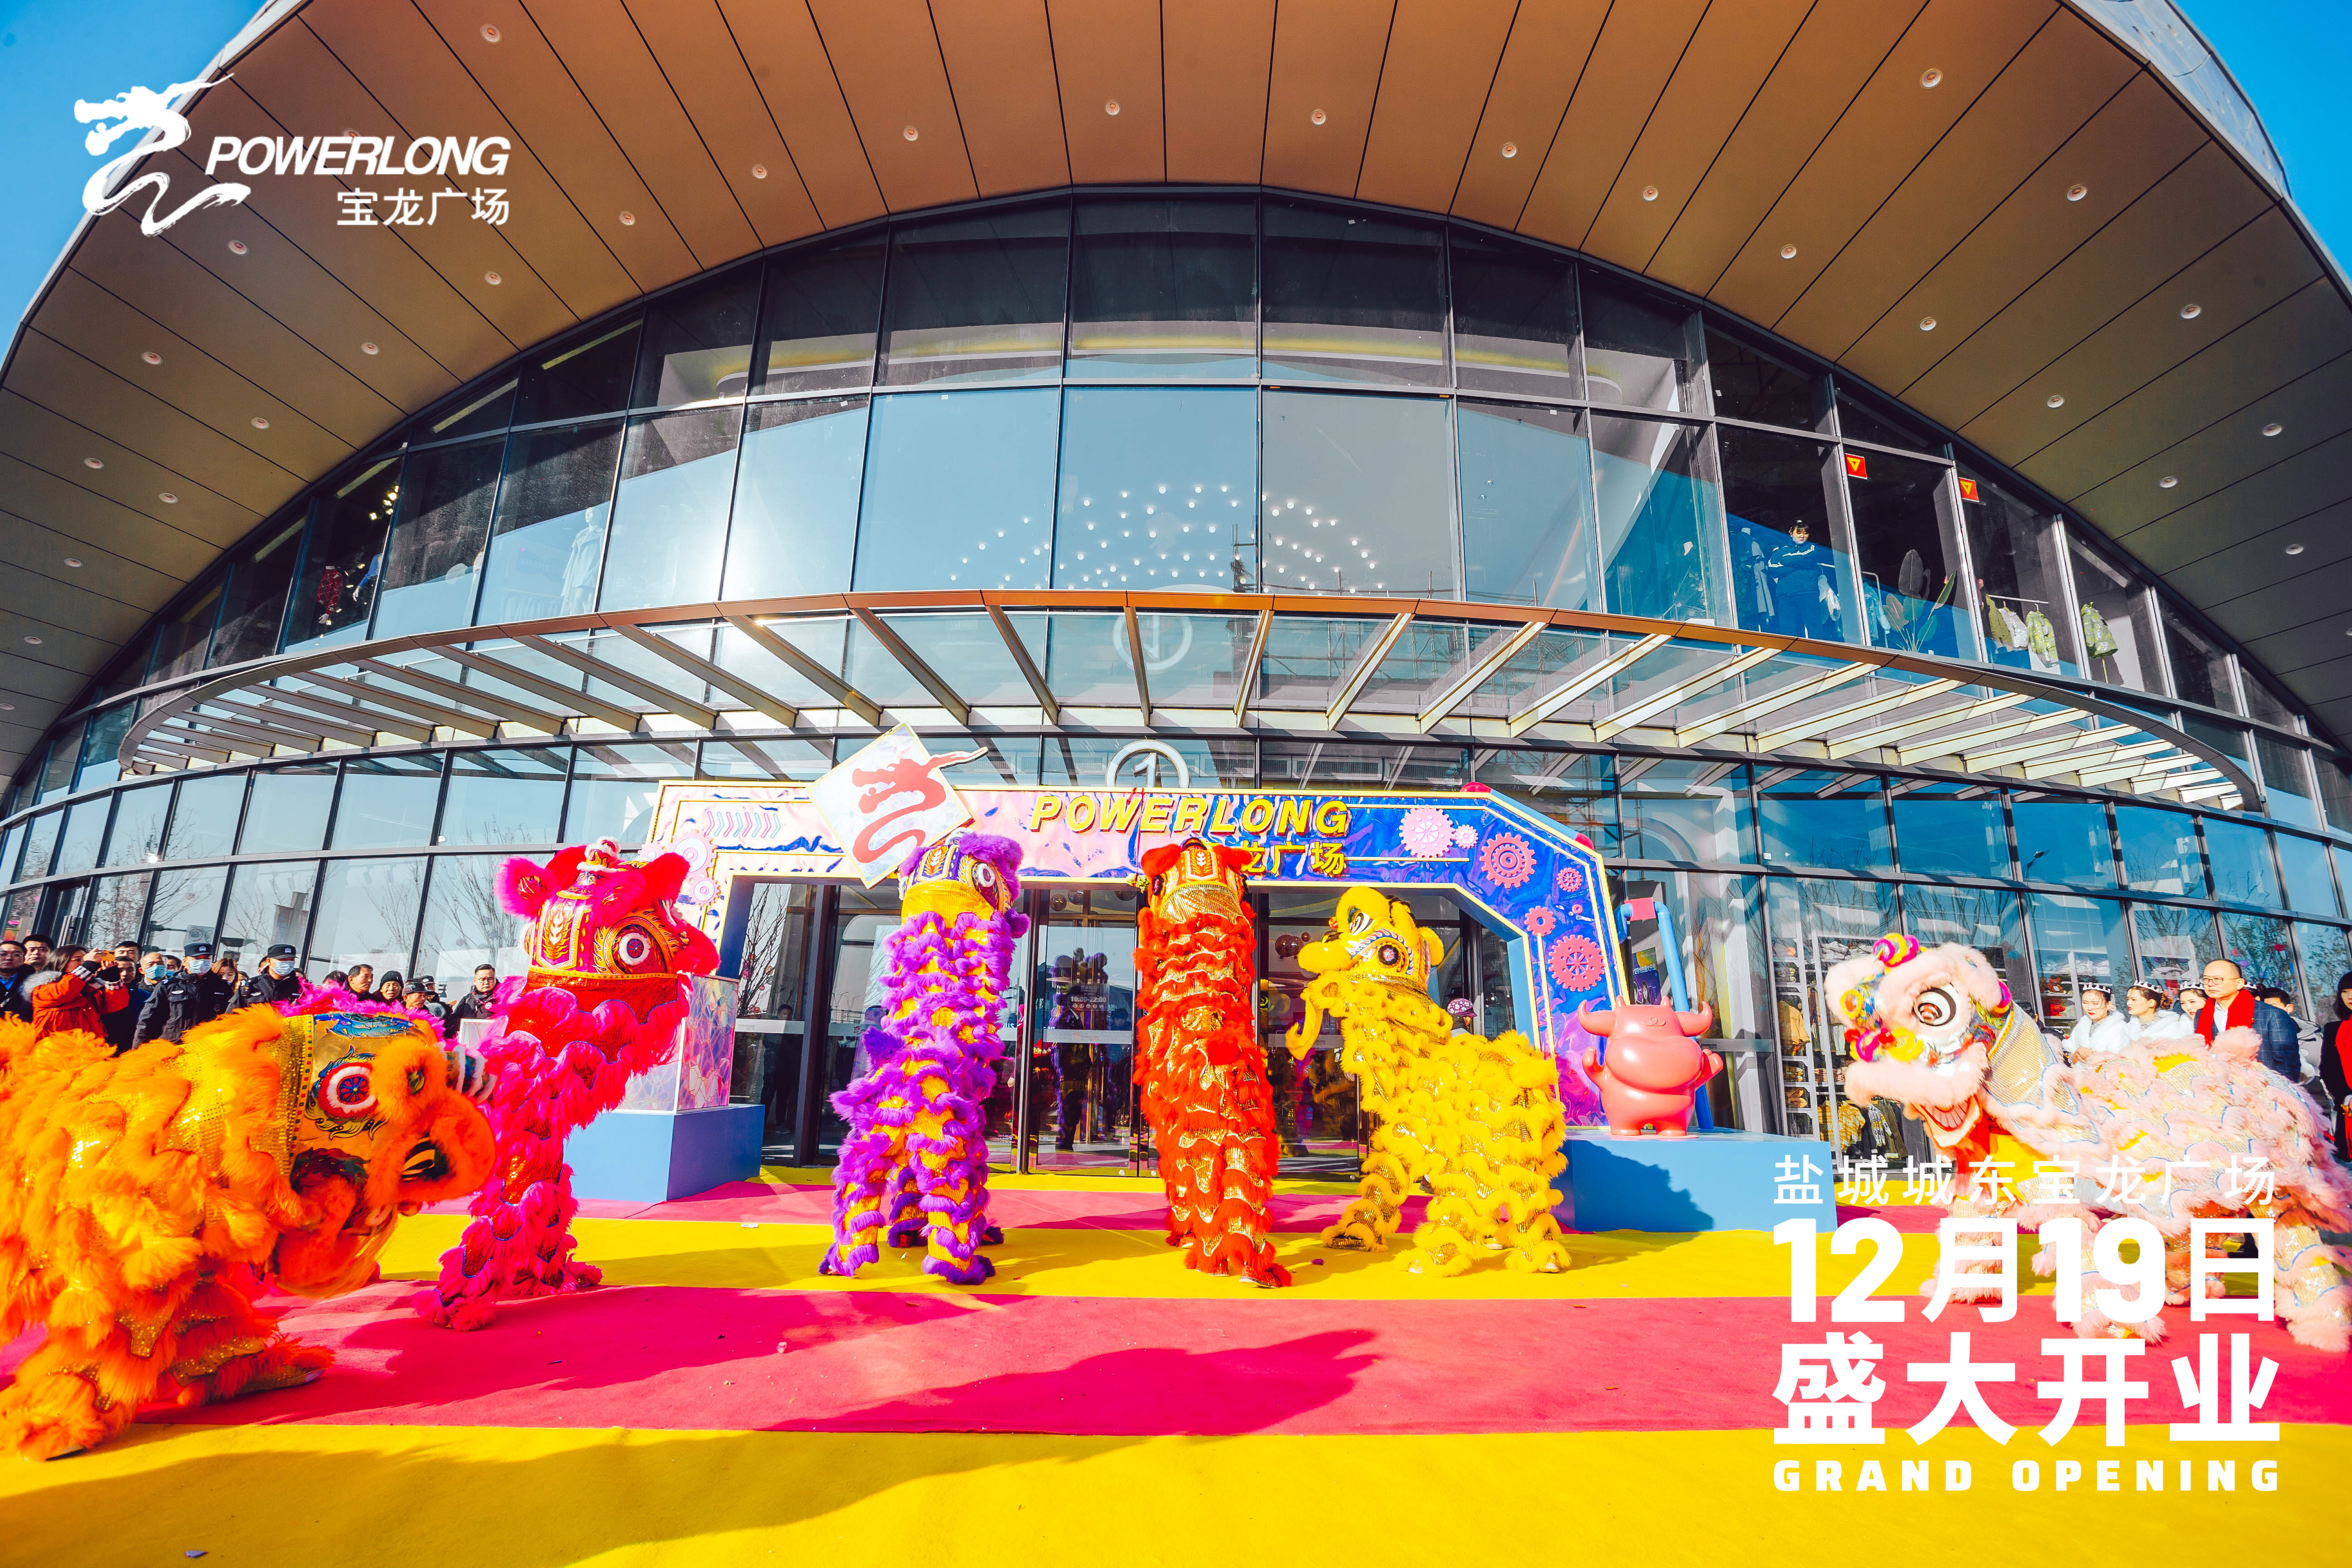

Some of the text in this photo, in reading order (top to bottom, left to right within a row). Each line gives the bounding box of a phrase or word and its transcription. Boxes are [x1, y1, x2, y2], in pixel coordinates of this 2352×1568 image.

[1029, 795, 1348, 837] POWERLONG
[1202, 839, 1345, 876] 龙广场
